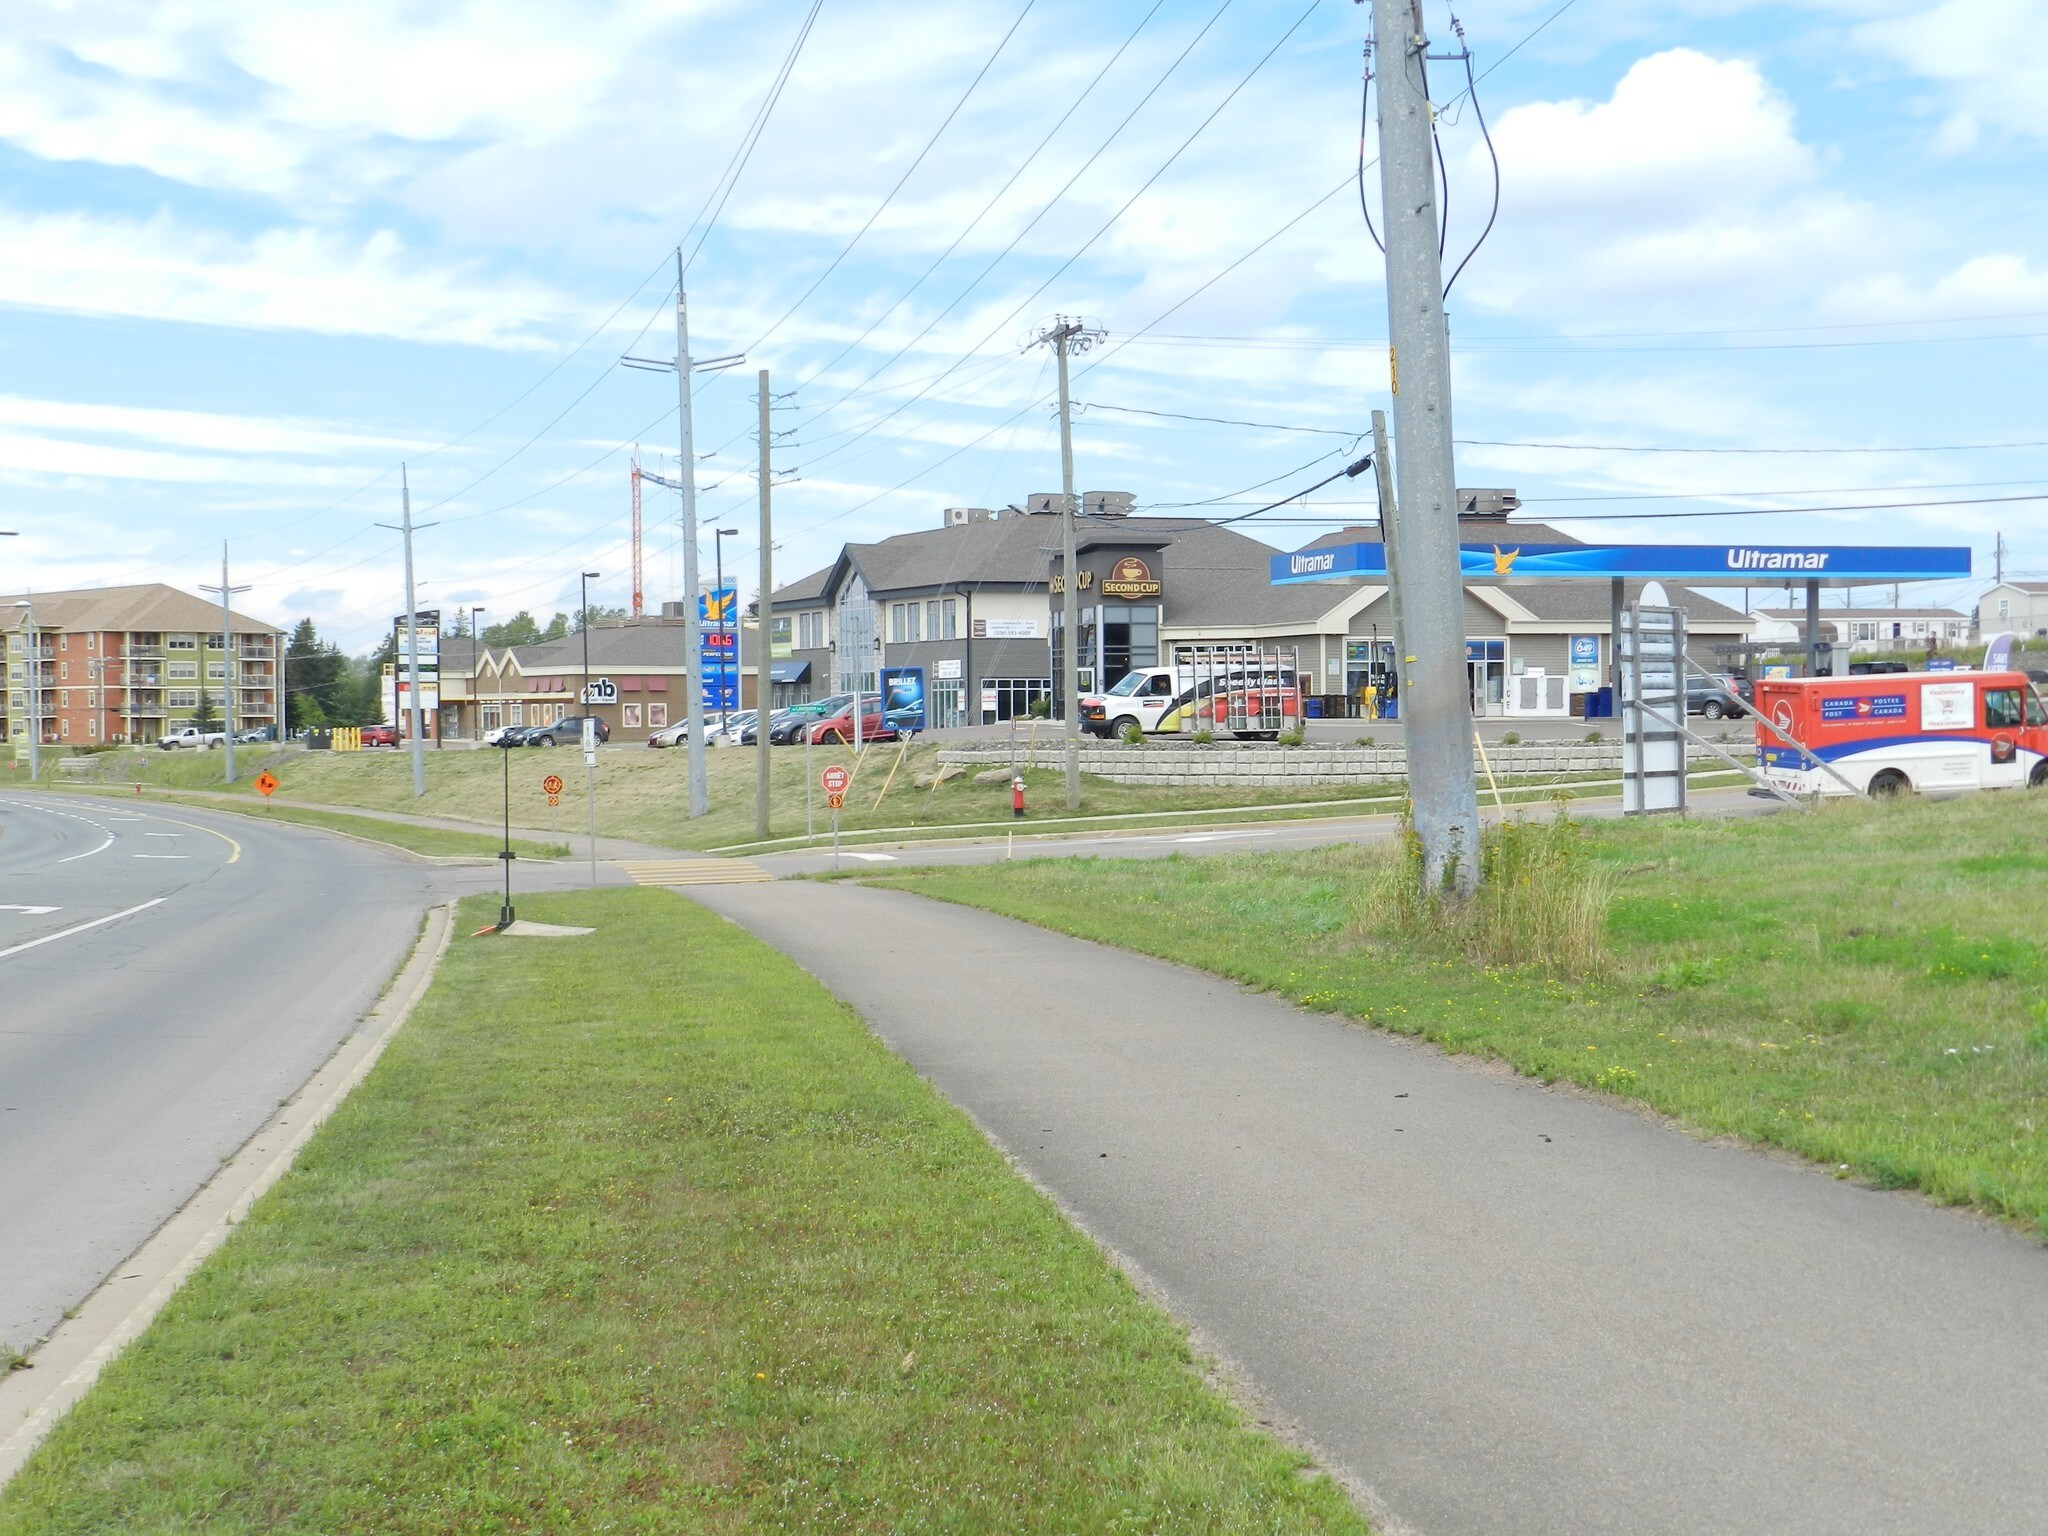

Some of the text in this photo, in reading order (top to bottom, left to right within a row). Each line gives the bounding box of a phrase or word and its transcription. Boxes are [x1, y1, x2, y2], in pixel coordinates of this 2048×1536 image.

[1291, 554, 1335, 574] Ultramar
[1728, 549, 1828, 569] Ultramar
[1105, 582, 1158, 592] SECOND CUP
[889, 677, 916, 686] BRILLEZ
[826, 771, 844, 779] ARRÊT
